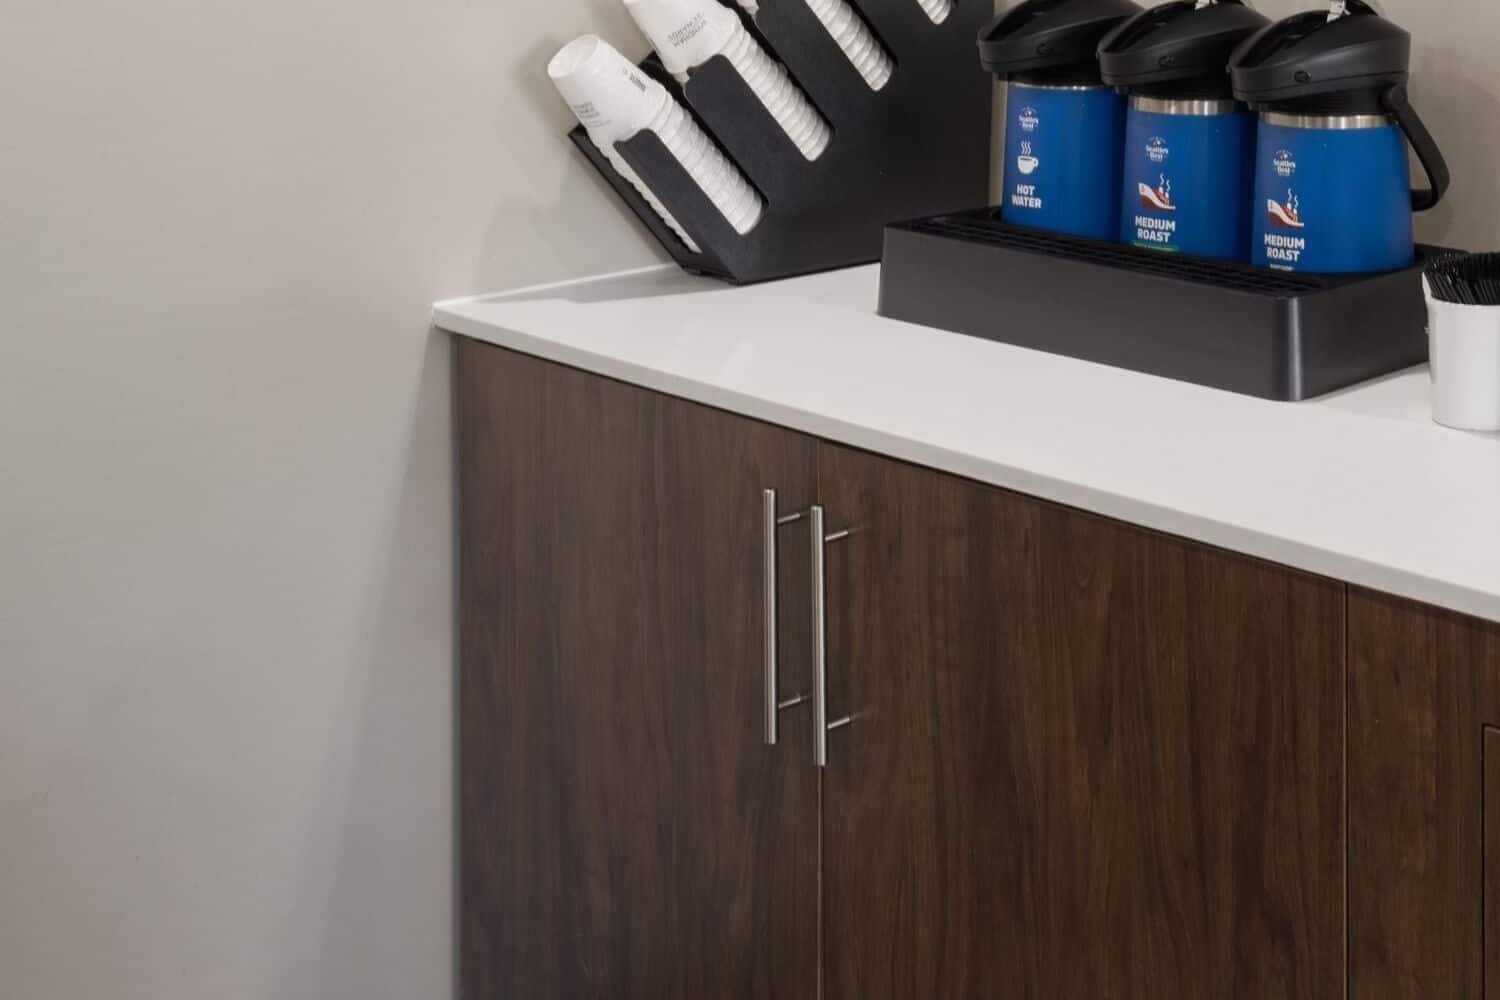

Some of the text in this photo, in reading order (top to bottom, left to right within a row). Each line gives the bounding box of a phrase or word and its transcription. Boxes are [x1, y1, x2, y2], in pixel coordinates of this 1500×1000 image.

[1016, 184, 1035, 196] HOT
[1012, 194, 1042, 209] WATER
[1135, 215, 1176, 232] MEDIUM
[1137, 228, 1171, 243] ROAST
[1264, 233, 1304, 250] MEDIUM
[1266, 246, 1300, 262] ROAST
